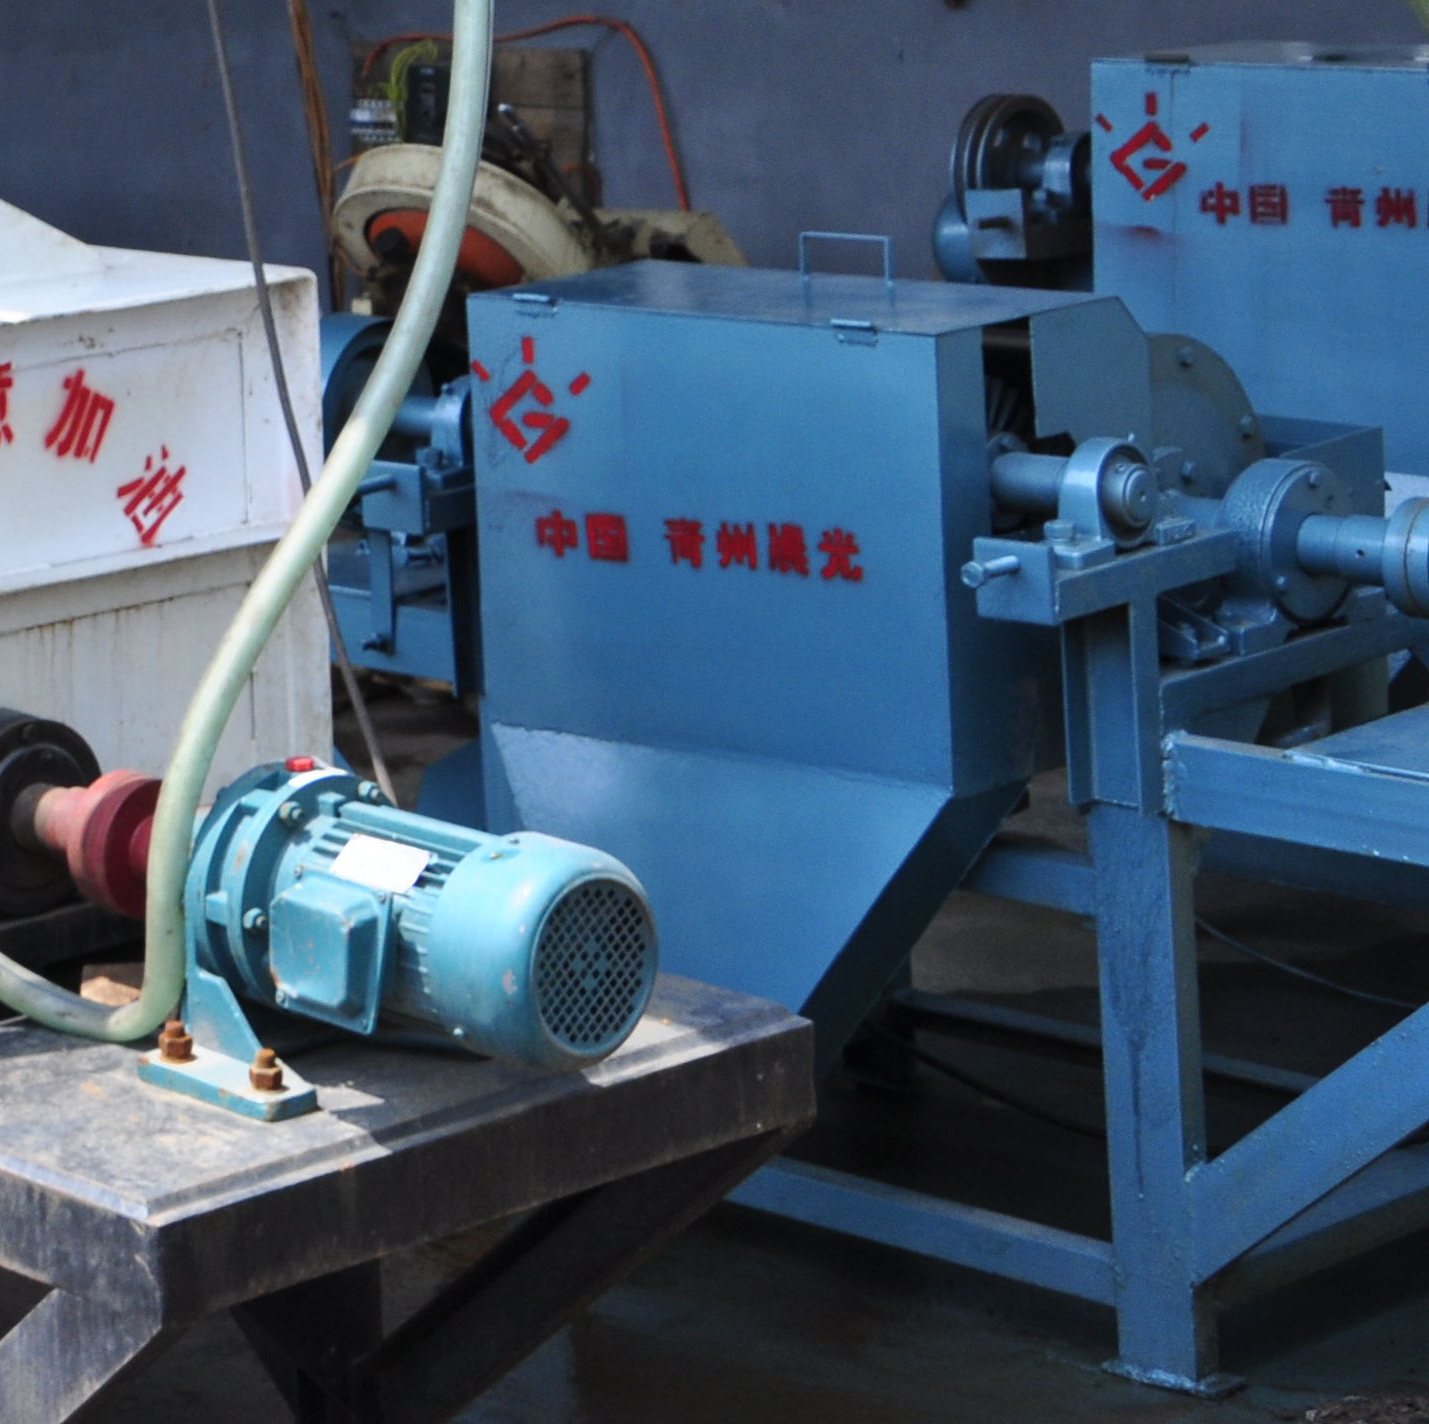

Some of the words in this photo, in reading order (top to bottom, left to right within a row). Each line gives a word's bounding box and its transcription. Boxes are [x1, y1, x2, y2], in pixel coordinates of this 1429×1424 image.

[1200, 181, 1289, 226] 中国
[1325, 185, 1429, 229] 青州
[535, 508, 629, 563] 中国
[663, 517, 874, 582] 青州晨光
